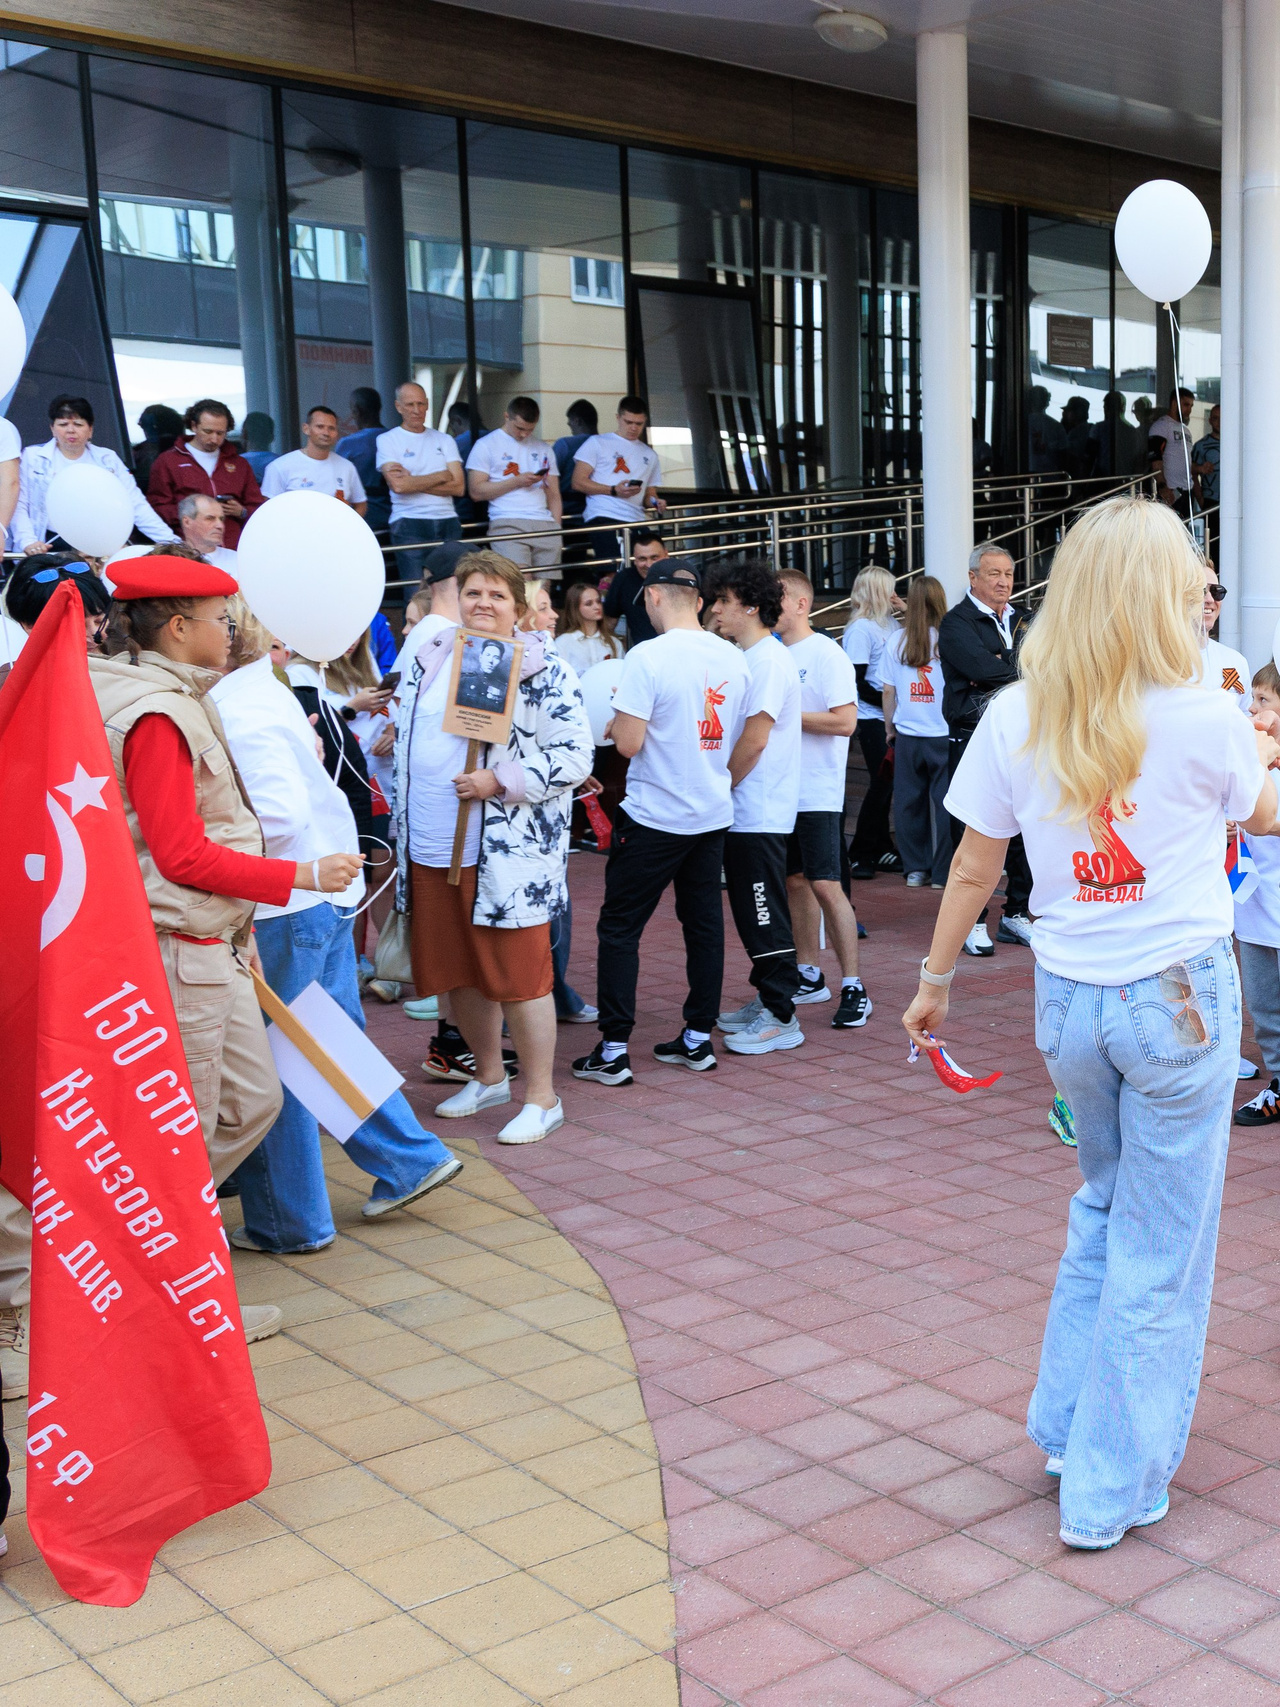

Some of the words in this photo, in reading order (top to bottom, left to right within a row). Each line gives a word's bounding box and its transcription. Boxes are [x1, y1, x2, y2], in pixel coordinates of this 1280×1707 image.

[910, 682, 924, 695] 80
[1072, 851, 1110, 884] 80
[83, 980, 168, 1066] 150
